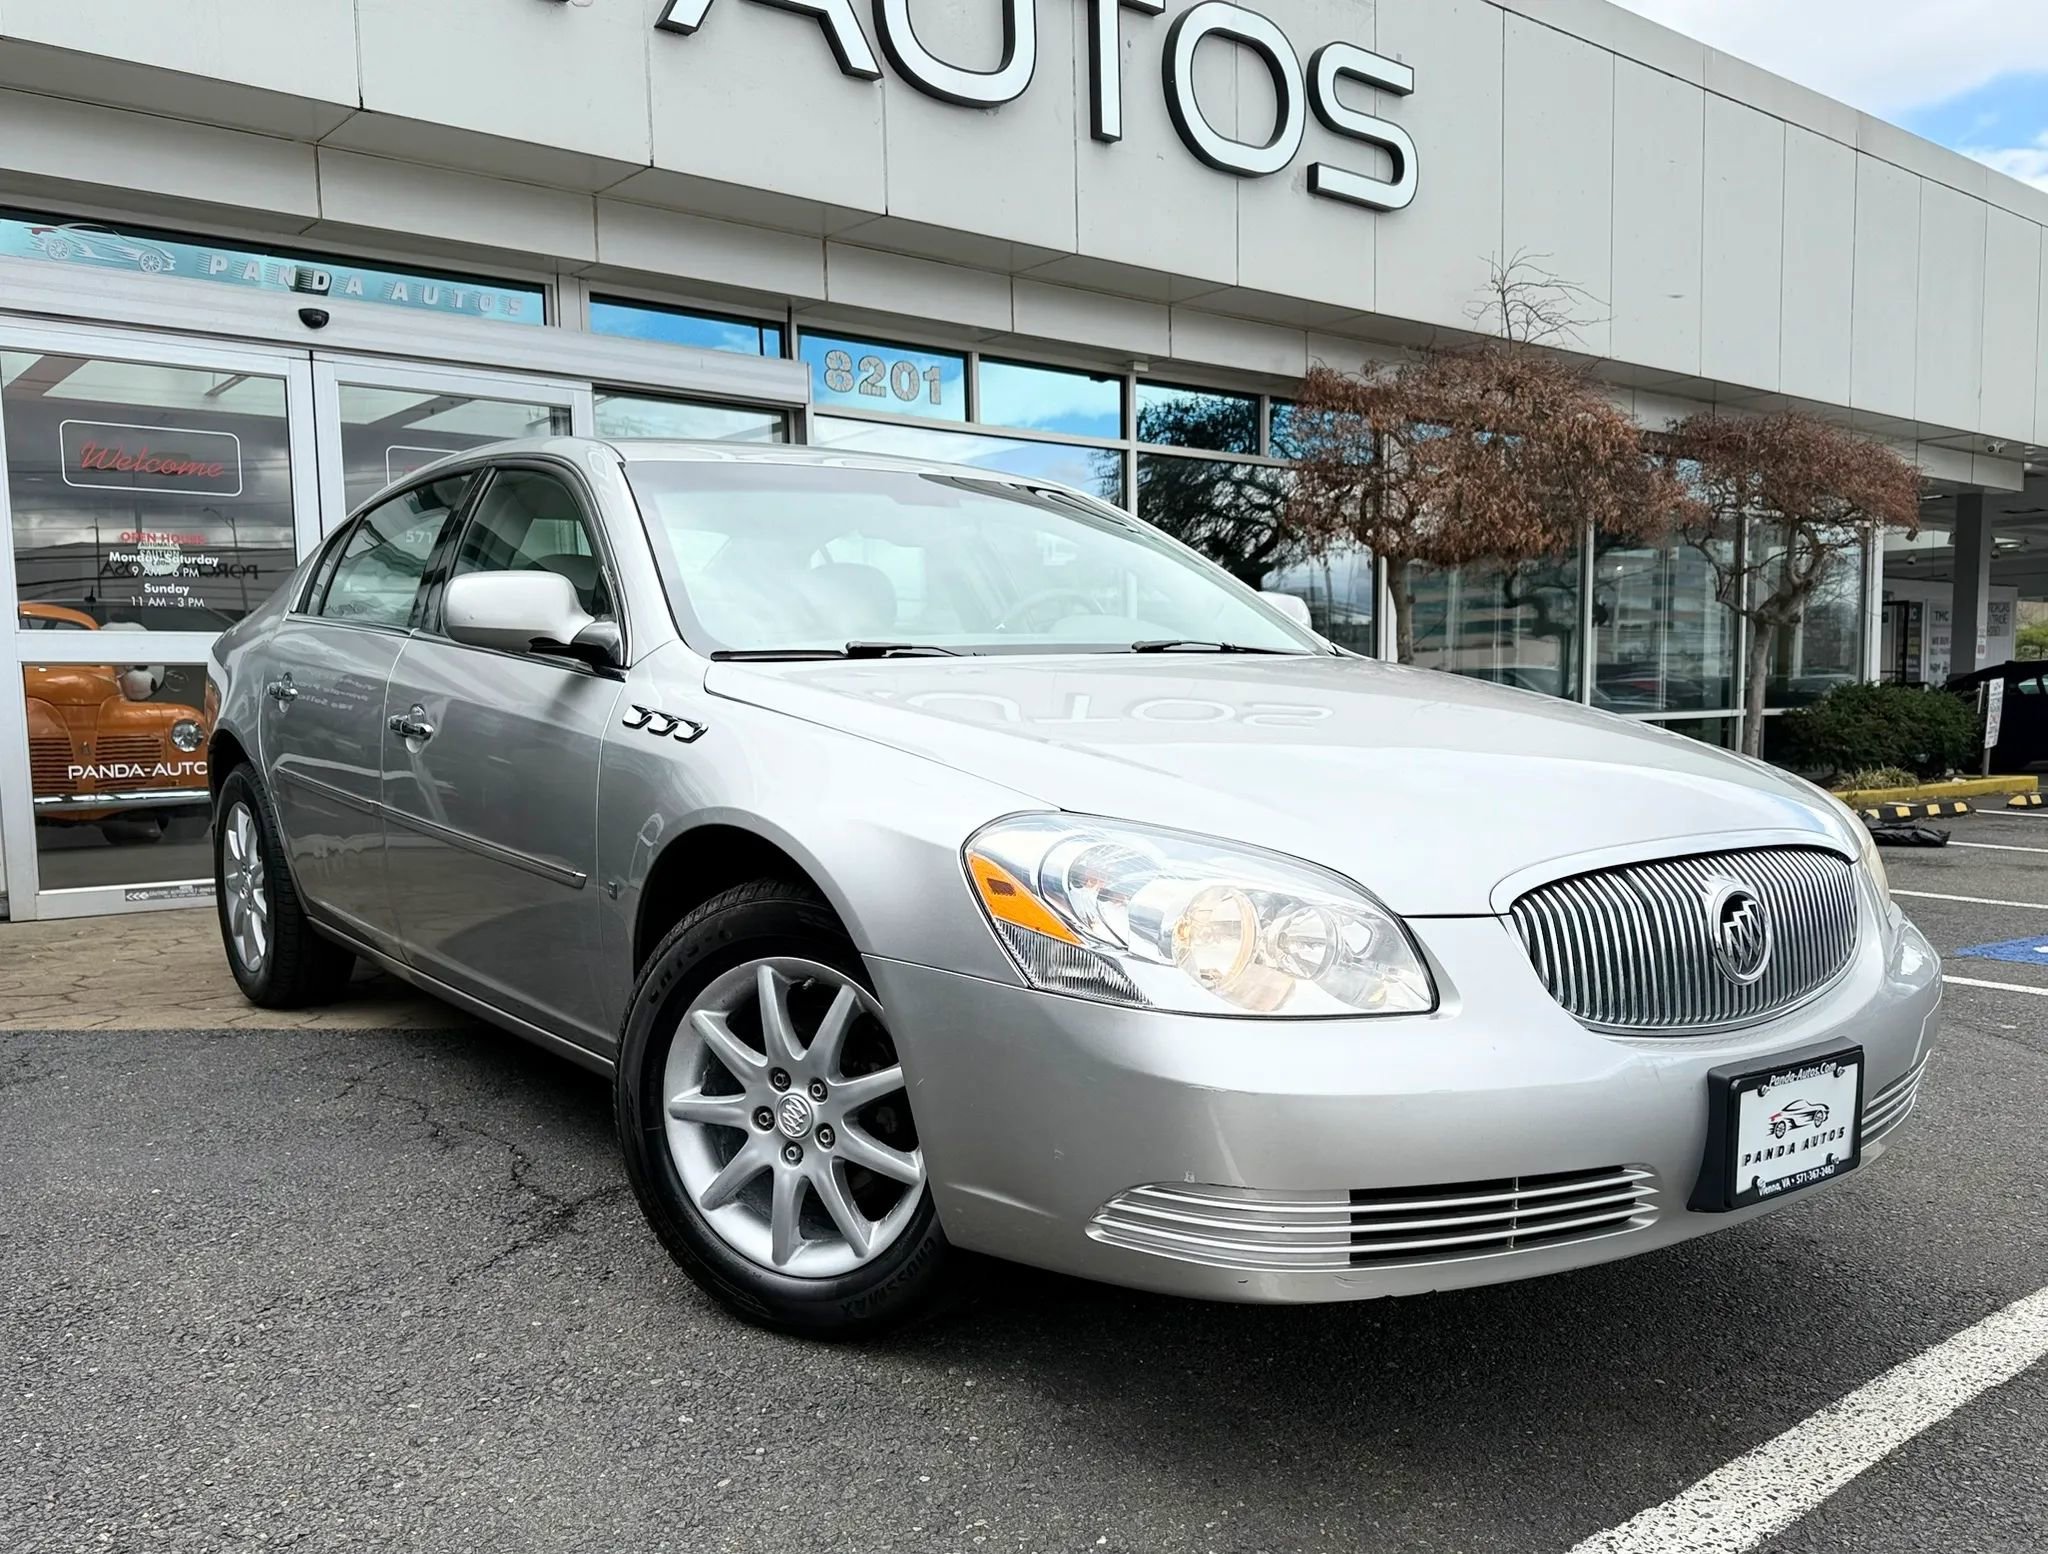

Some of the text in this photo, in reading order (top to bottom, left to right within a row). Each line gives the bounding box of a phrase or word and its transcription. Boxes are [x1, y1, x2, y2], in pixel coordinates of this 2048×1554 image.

[207, 254, 524, 316] PANDA AUTOS
[824, 350, 942, 405] 8201
[80, 440, 225, 477] Welcome
[120, 531, 156, 543] OPEN
[109, 552, 219, 568] Monday-Saturday
[131, 566, 200, 578] 9 AM 6 PM
[144, 583, 190, 596] Sunday
[131, 596, 143, 607] 11
[148, 597, 167, 607] AM
[177, 598, 184, 607] 3
[188, 598, 205, 608] PM
[1769, 1062, 1837, 1088] Panda-Autos.Com
[1743, 1126, 1846, 1167] PANDA AUTOS
[1781, 1177, 1791, 1189] VA
